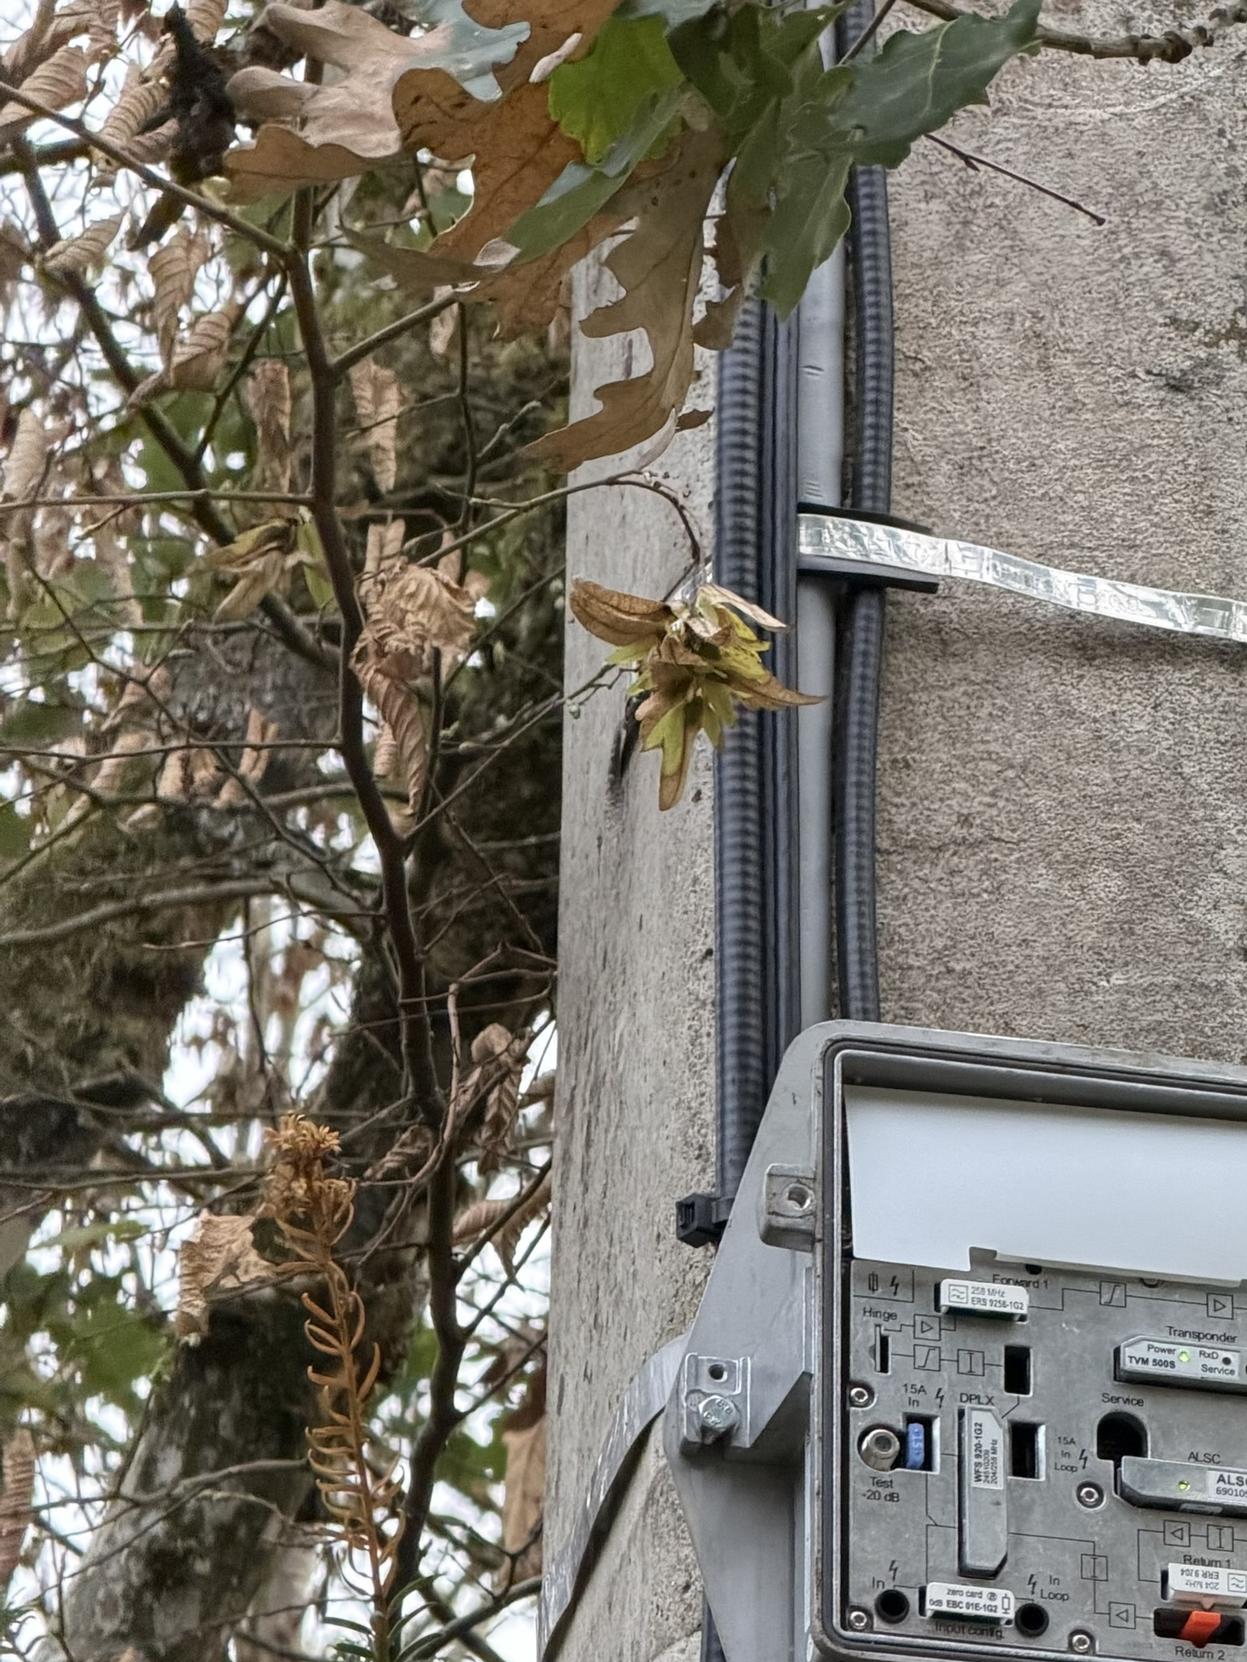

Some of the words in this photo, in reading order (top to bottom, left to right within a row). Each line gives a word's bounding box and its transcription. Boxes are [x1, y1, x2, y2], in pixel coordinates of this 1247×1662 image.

[993, 1273, 1040, 1289] Forward
[863, 1306, 898, 1321] Hinge
[1166, 1325, 1238, 1343] Transponder
[1147, 1344, 1177, 1355] Power
[1199, 1349, 1219, 1360] RxD
[1128, 1355, 1149, 1366] TVM
[1201, 1363, 1236, 1376] Service
[903, 1383, 927, 1395] 15A
[908, 1396, 920, 1407] In
[960, 1392, 995, 1406] DPLX
[1101, 1392, 1145, 1407] Service
[1057, 1436, 1076, 1445] 15A
[1061, 1450, 1071, 1459] In
[1187, 1451, 1221, 1465] ALSC
[973, 1461, 983, 1483] WFS
[1054, 1462, 1078, 1473] Loop
[870, 1476, 894, 1489] Test
[862, 1489, 881, 1501] -20
[884, 1492, 900, 1503] dB
[872, 1576, 885, 1590] In
[1049, 1574, 1060, 1586] In
[947, 1588, 964, 1597] zero
[966, 1590, 983, 1599] card
[1040, 1588, 1070, 1603] Loop
[935, 1620, 965, 1635] Input
[1174, 1646, 1214, 1660] Return
[1217, 1649, 1226, 1661] 2
